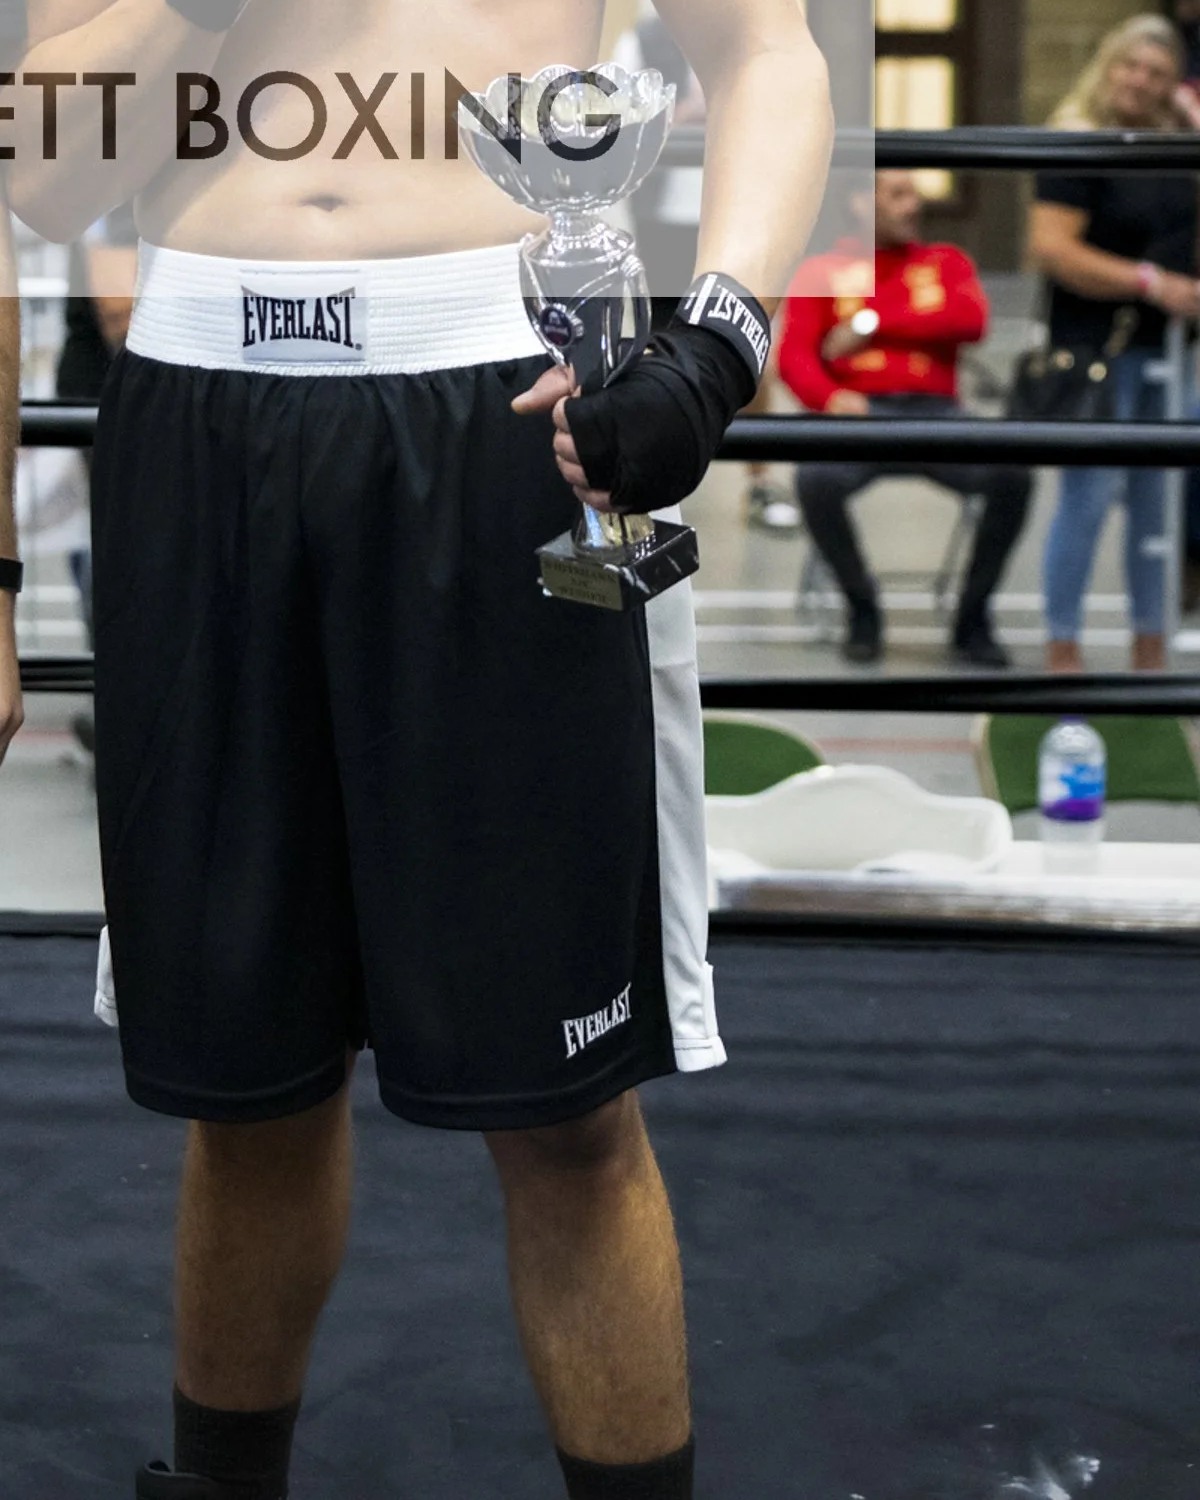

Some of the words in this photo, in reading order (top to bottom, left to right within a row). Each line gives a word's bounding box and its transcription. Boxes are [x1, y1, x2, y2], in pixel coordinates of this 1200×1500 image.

[241, 284, 356, 349] EVERLAST
[707, 285, 770, 375] EVERLAST
[561, 981, 632, 1059] EVERLAST
